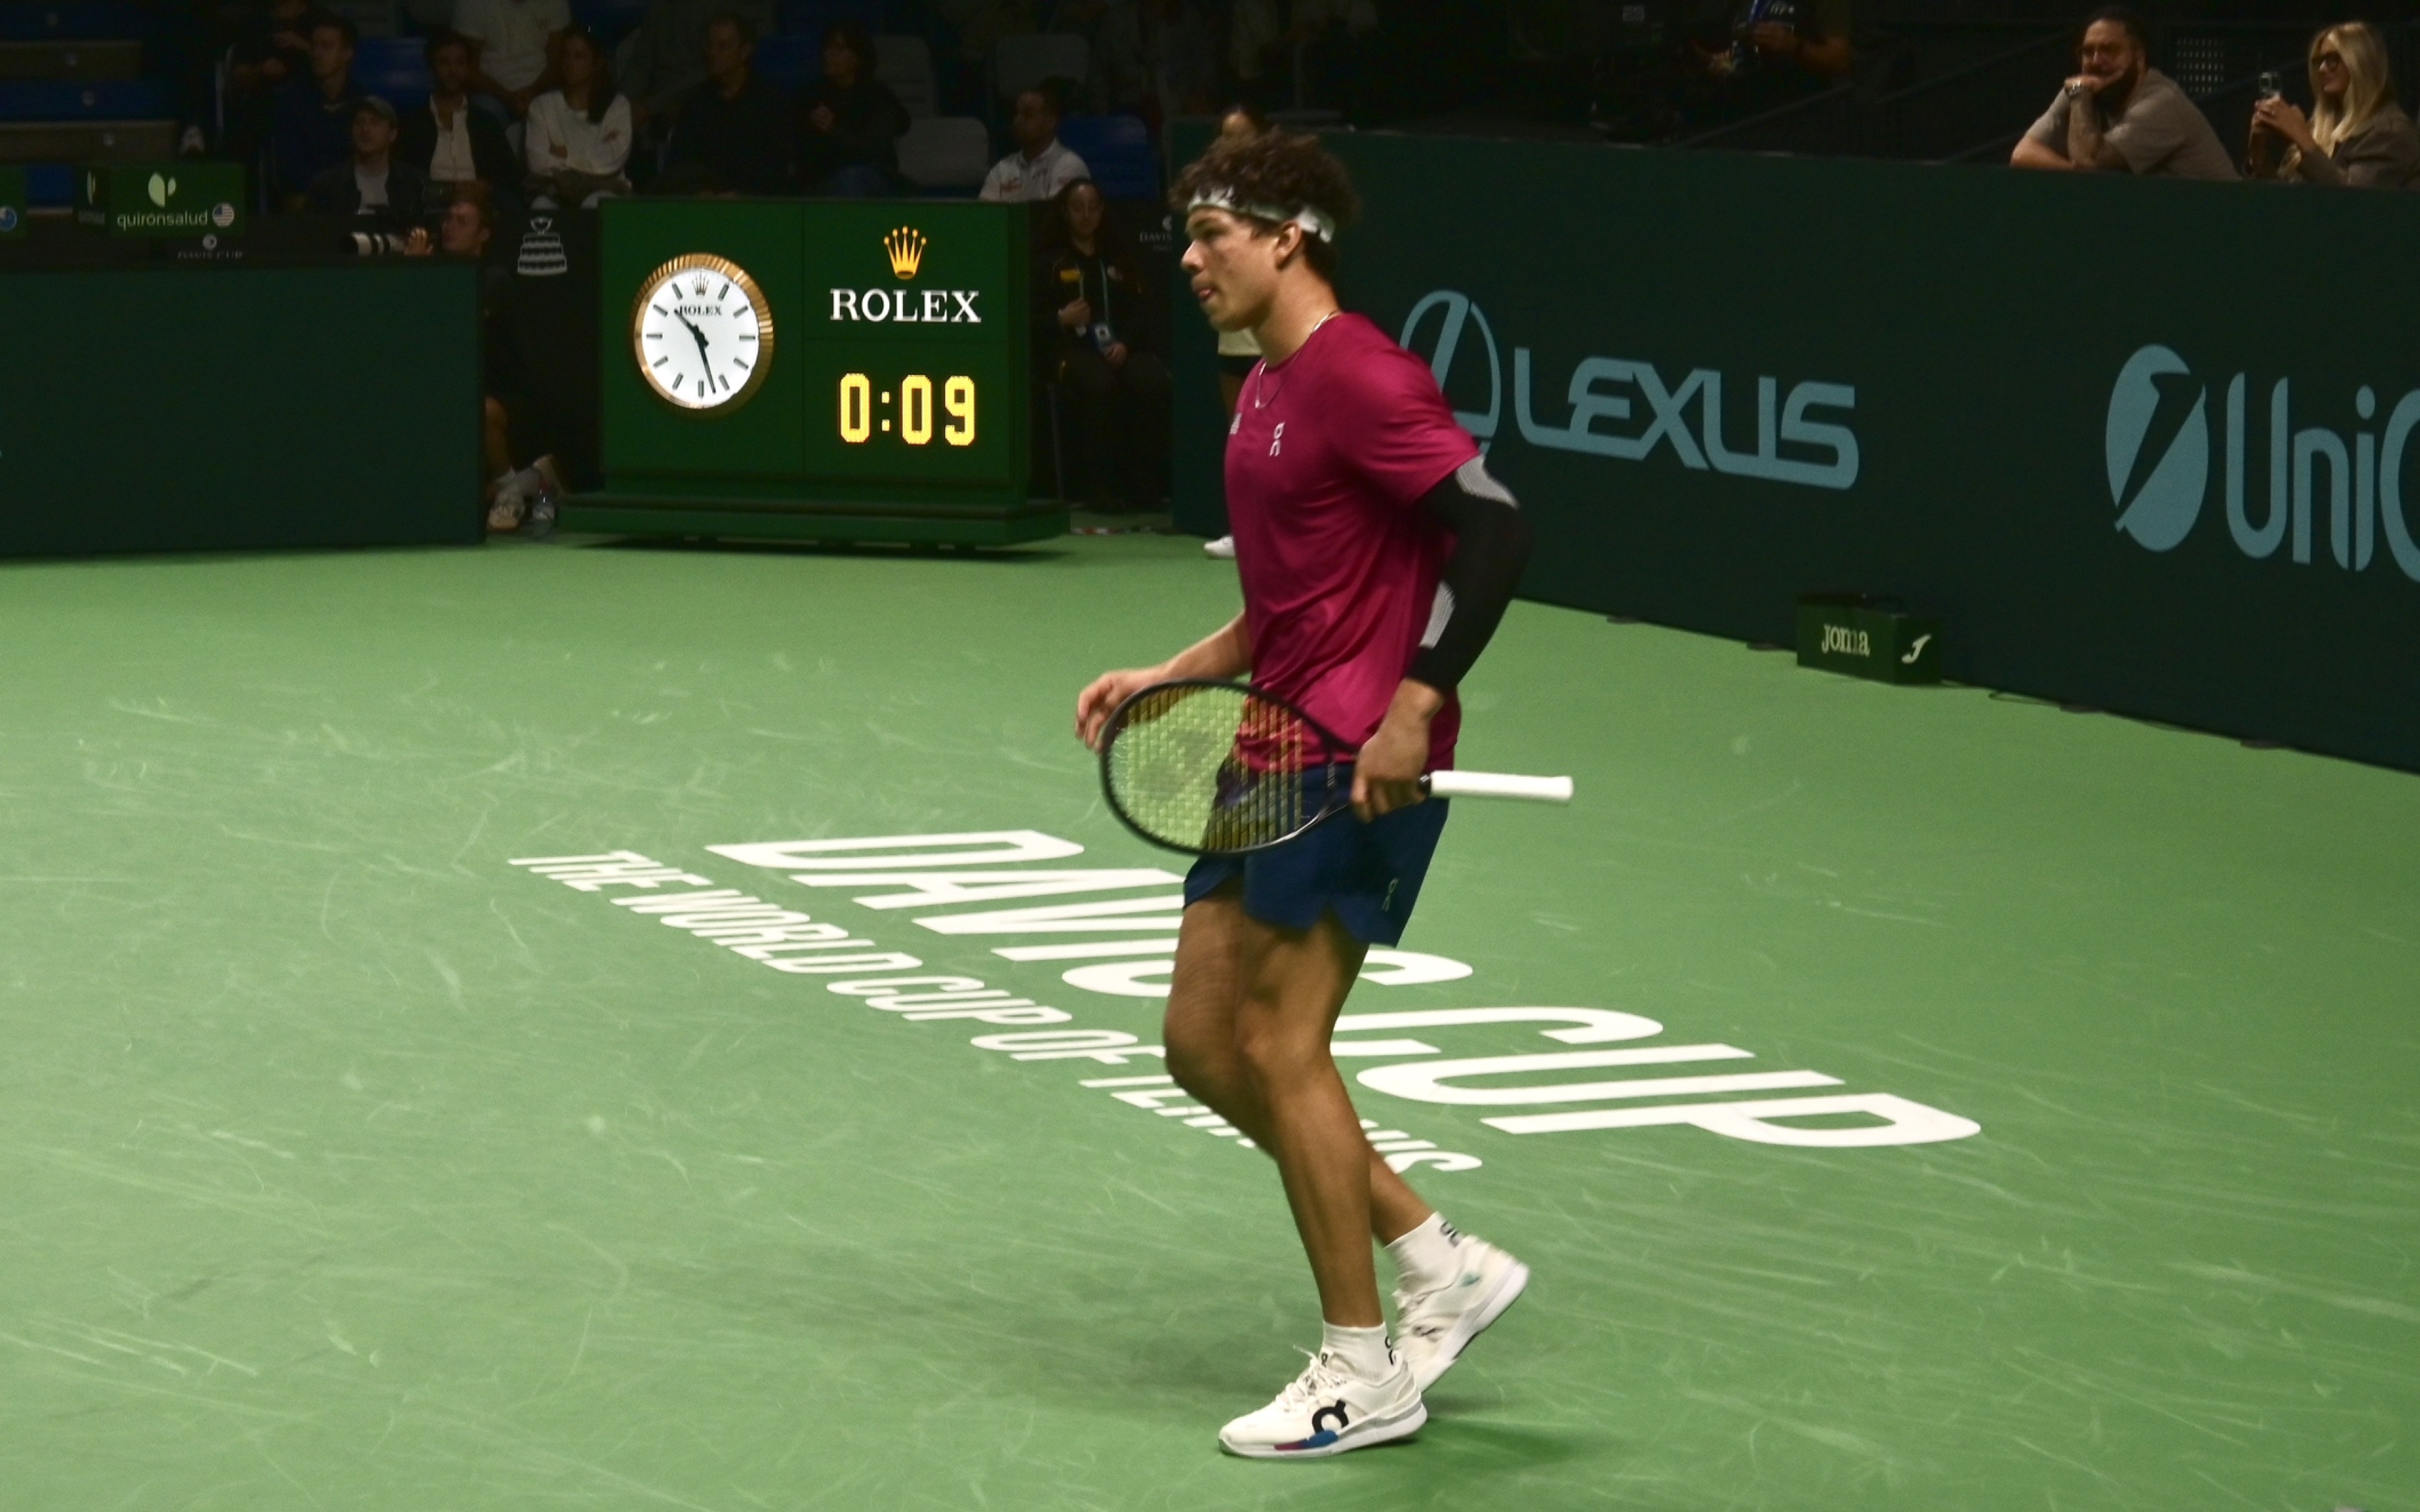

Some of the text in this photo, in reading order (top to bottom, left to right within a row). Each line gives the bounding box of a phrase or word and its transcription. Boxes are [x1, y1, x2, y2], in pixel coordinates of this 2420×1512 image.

[679, 305, 722, 316] ROLEX
[829, 287, 983, 323] ROLEX
[839, 372, 976, 446] 0:09
[1514, 347, 1859, 491] LEXUS
[507, 849, 1167, 1065] THE WORLD CUP OF
[1329, 1006, 1982, 1148] CUP
